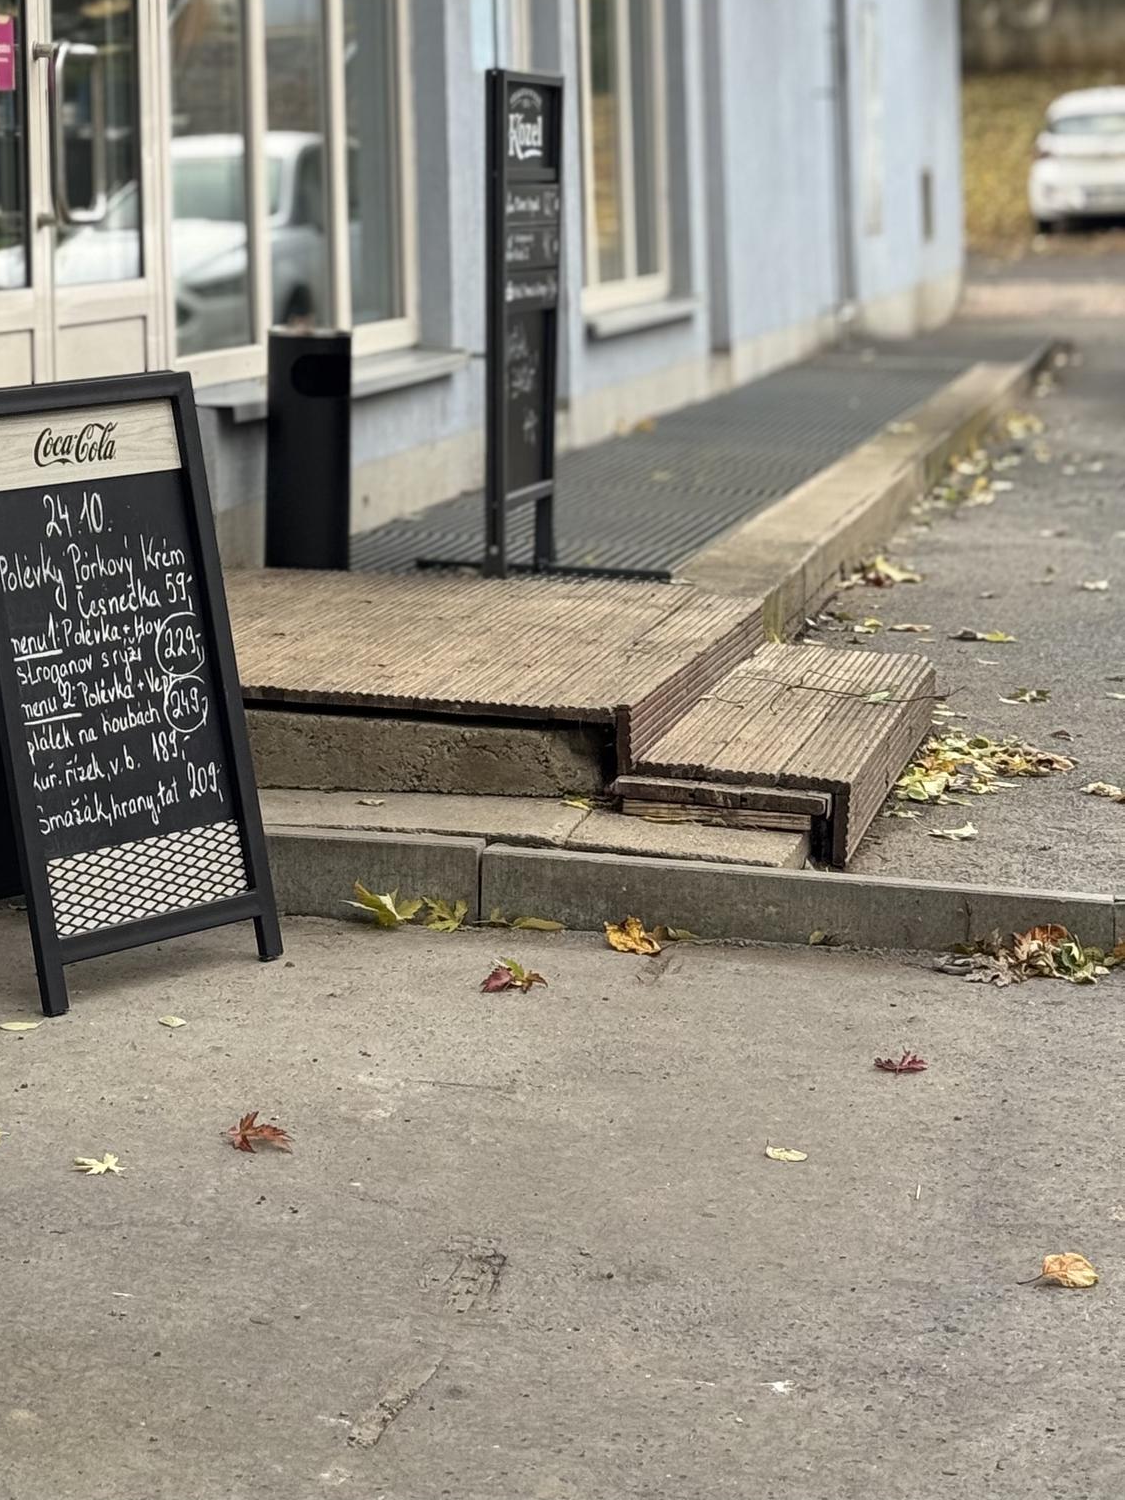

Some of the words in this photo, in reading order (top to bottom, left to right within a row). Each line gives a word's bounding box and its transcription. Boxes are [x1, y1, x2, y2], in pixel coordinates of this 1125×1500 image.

[508, 112, 543, 160] Kozel
[34, 421, 118, 468] Coca-Cola
[140, 533, 186, 571] Krém
[77, 578, 161, 619] Česnečka
[61, 616, 122, 648] Polévka
[77, 672, 135, 708] Polévka
[78, 729, 99, 745] na
[100, 698, 162, 737] houbách
